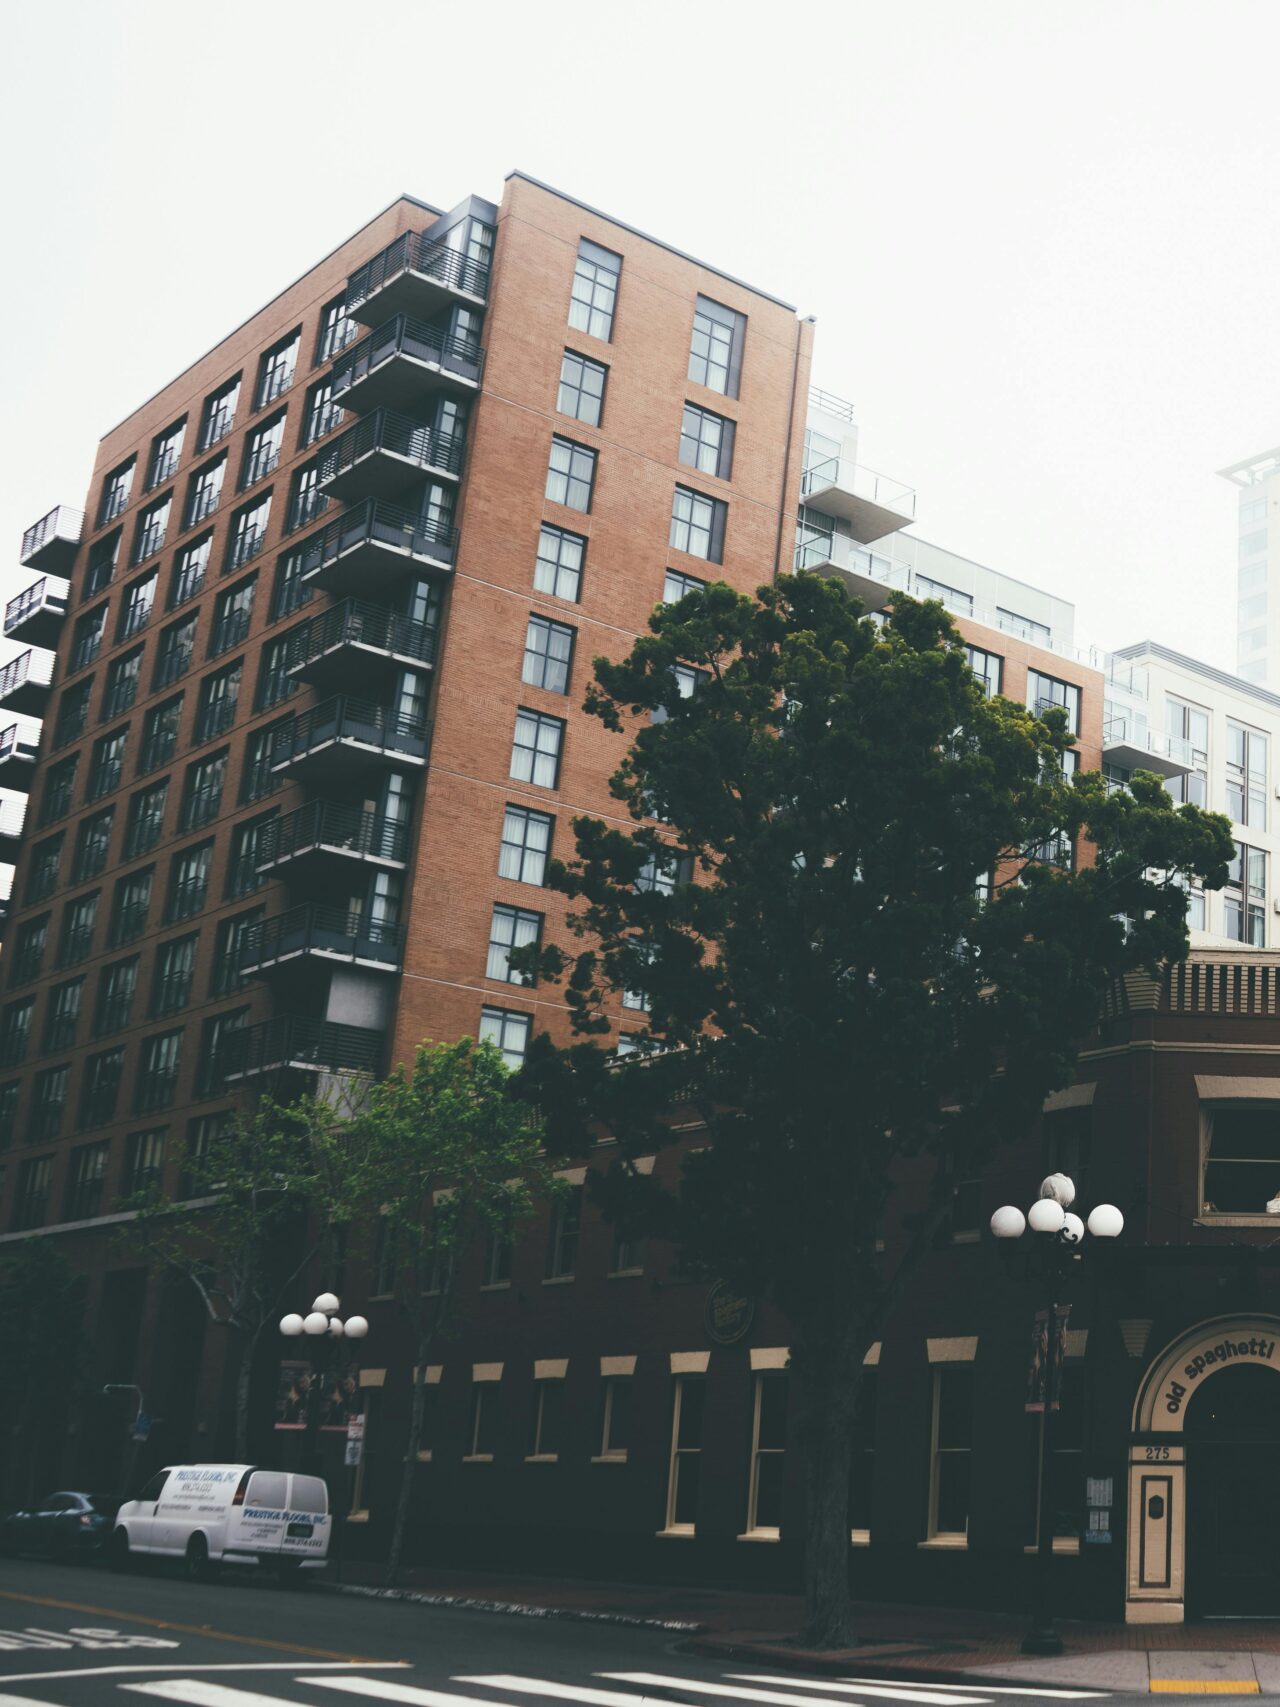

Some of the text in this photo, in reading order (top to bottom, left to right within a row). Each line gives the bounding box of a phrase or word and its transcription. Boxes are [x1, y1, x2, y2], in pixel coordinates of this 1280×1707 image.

[1166, 1381, 1187, 1414] old
[1184, 1338, 1275, 1380] spaghetti
[1146, 1447, 1169, 1459] 275
